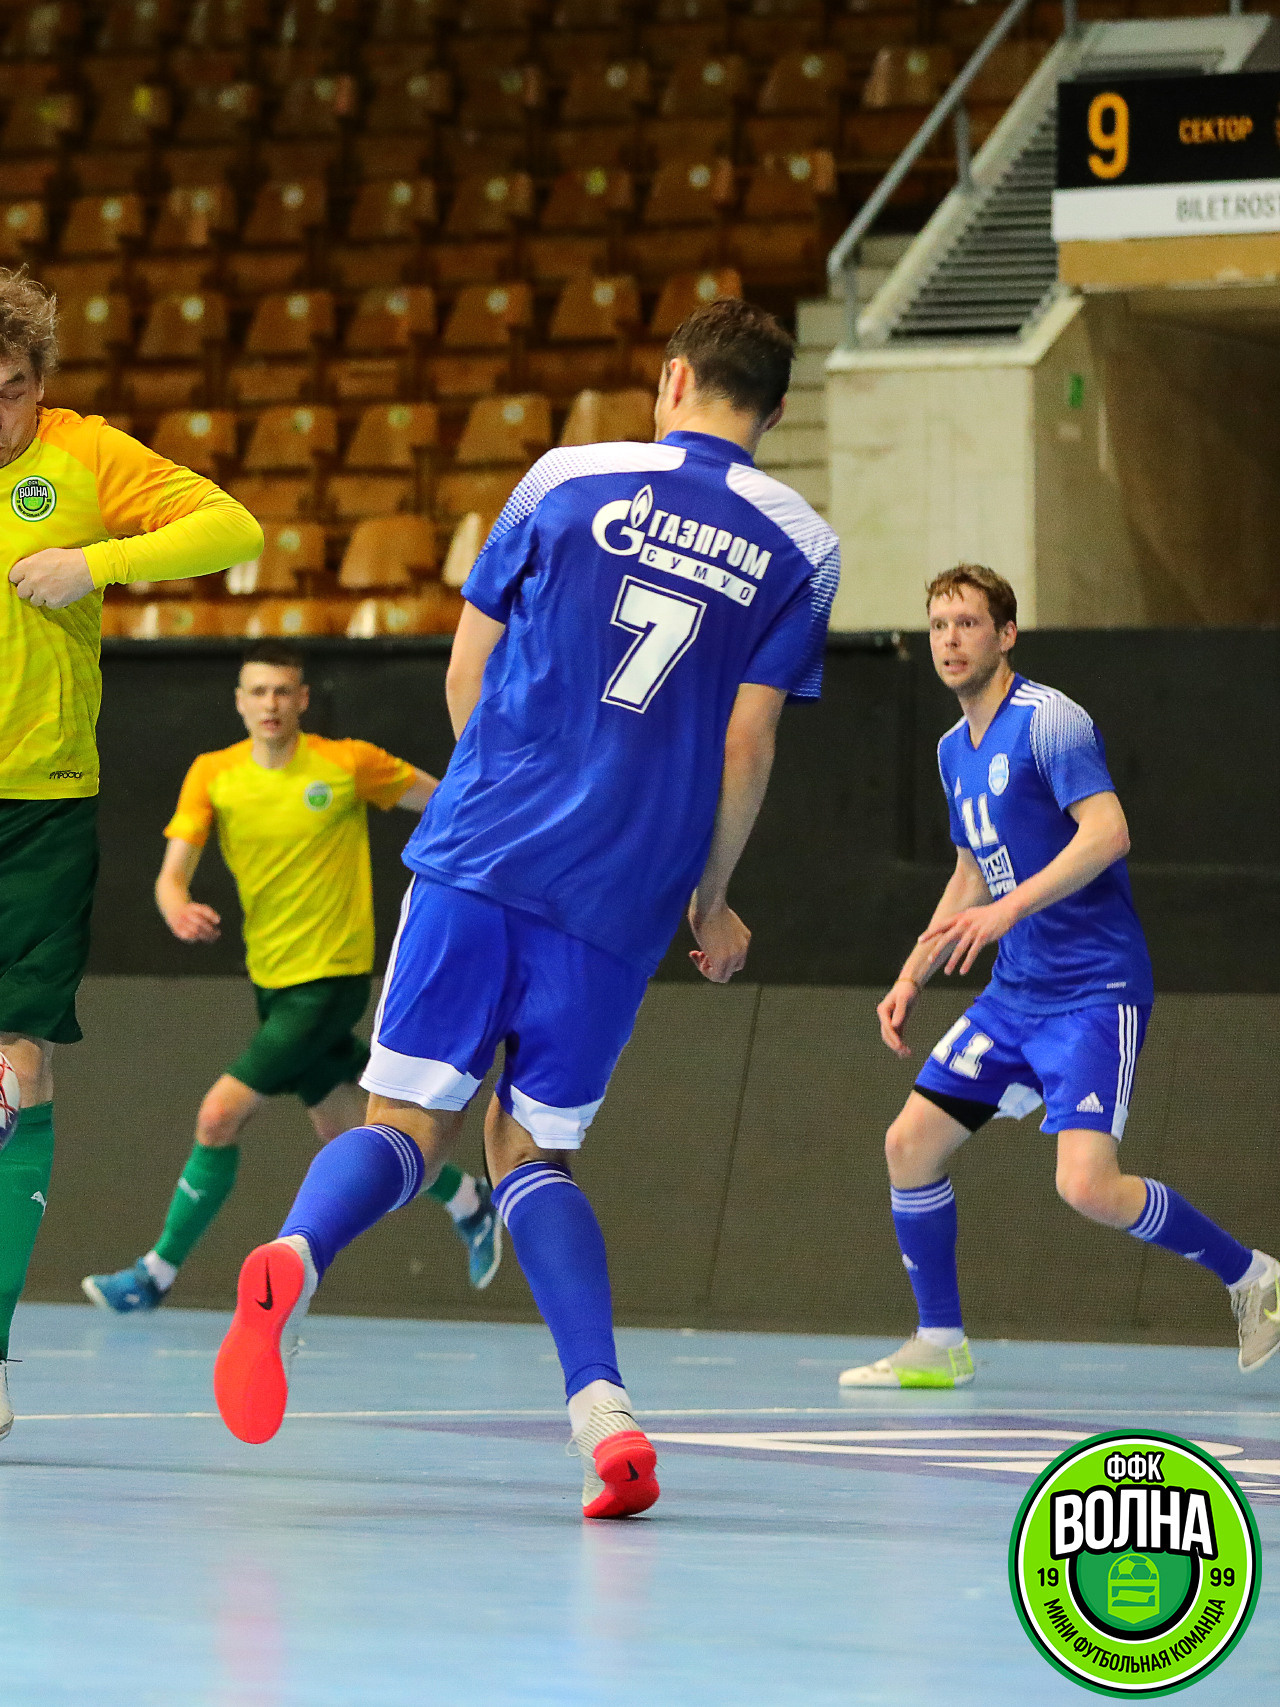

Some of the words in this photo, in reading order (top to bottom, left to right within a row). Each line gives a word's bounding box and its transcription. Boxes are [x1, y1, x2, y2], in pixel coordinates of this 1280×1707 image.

[1088, 92, 1129, 180] 9
[18, 486, 48, 499] ВОЛНА
[645, 548, 751, 602] СУМУО
[647, 508, 773, 580] ГАЗПРОМ
[600, 574, 708, 714] 7
[961, 792, 1000, 851] 11
[929, 1014, 995, 1081] 11
